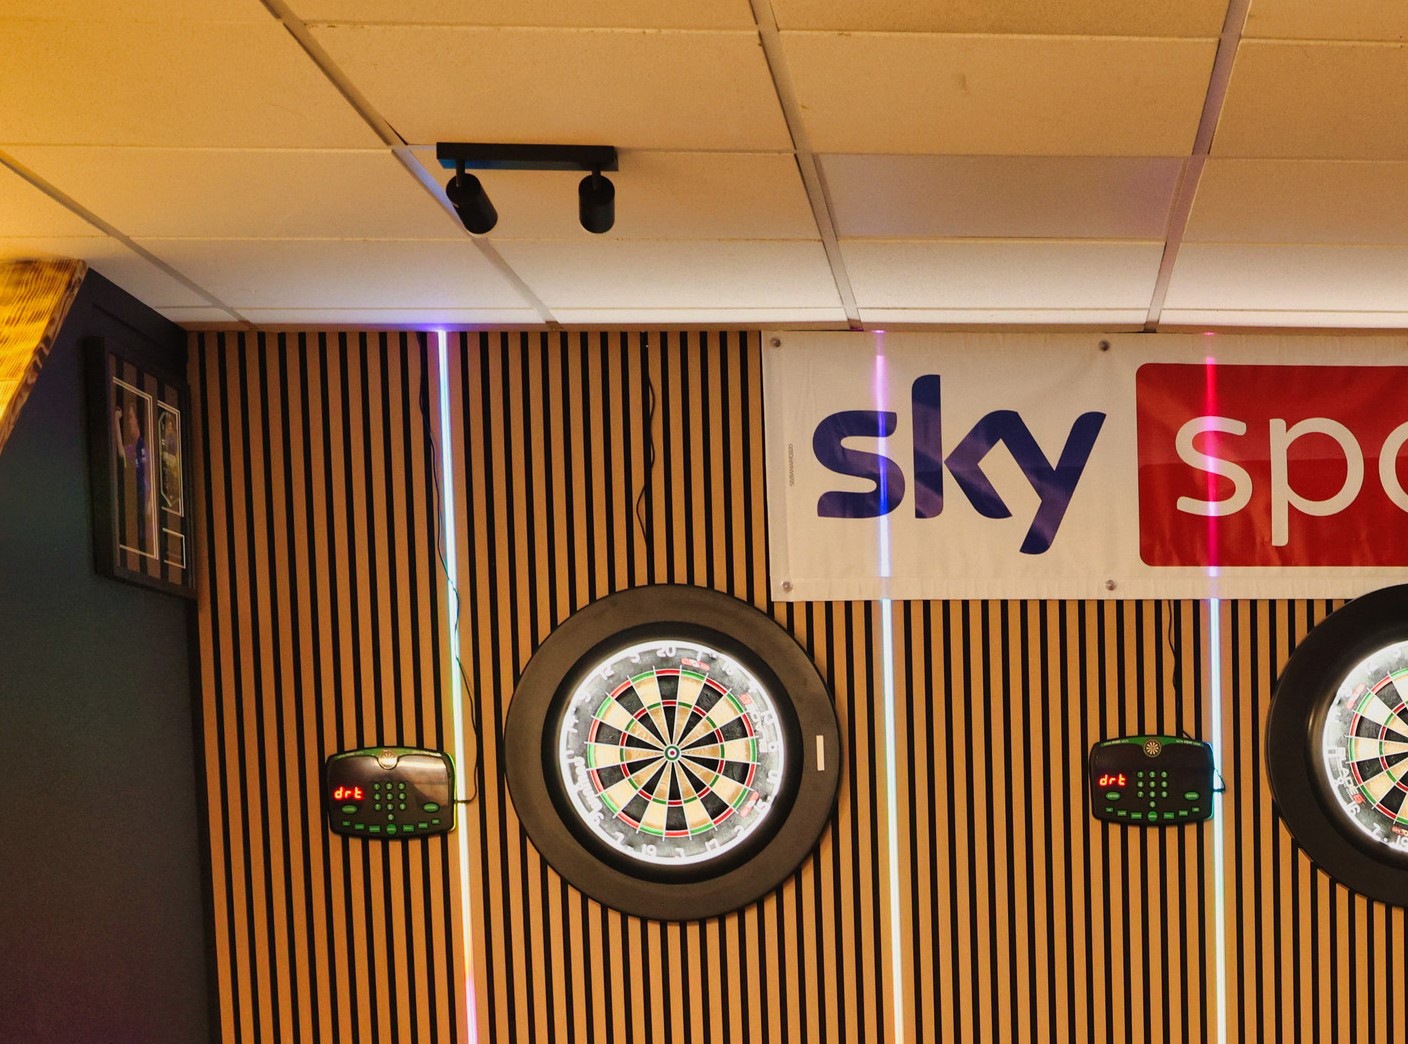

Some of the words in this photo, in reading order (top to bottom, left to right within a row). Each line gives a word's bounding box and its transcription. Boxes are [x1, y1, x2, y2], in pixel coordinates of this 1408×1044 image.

[812, 374, 1107, 555] sky
[1099, 774, 1126, 786] drt
[334, 787, 363, 800] drt
